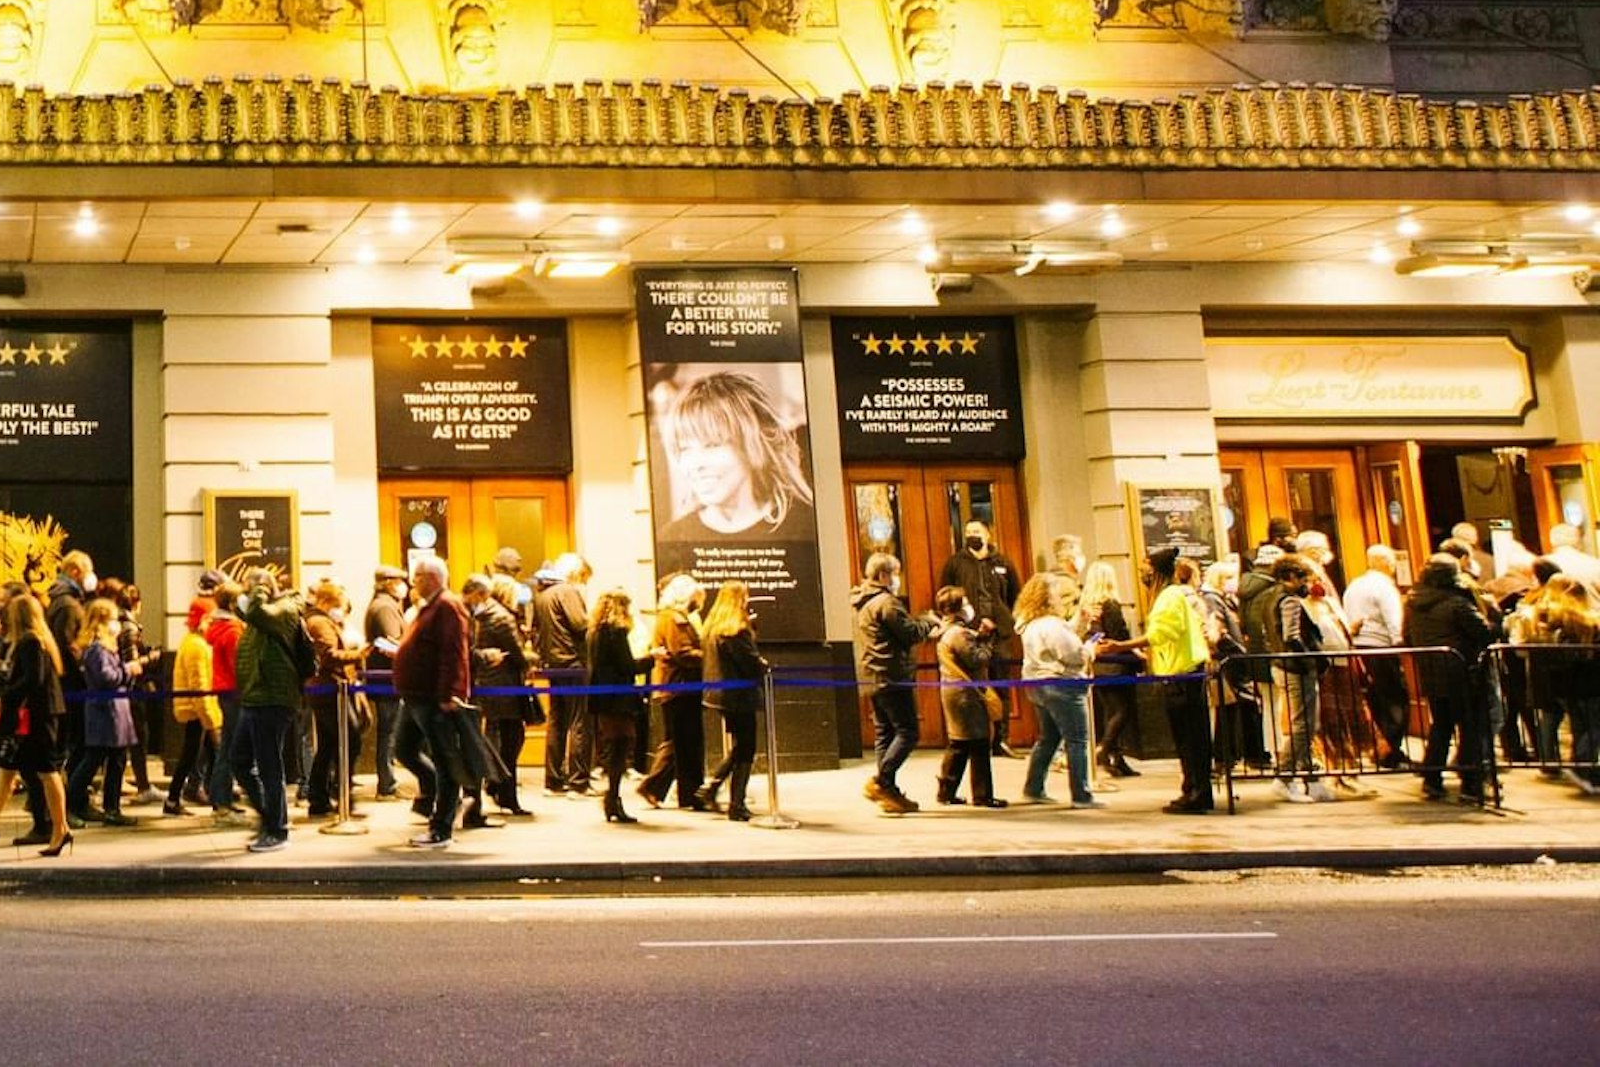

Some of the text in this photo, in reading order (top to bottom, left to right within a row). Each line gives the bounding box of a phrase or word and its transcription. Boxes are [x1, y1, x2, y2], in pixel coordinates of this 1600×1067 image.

[650, 292, 788, 305] THERE COULDN’T BE
[671, 307, 769, 319] A BETTER TIME
[666, 321, 695, 335] FOR
[697, 321, 728, 335] THIS
[860, 394, 989, 407] A SEISMIC POWER!
[41, 404, 75, 418] TALE
[410, 407, 531, 422] THIS IS AS GOOD
[866, 409, 903, 420] RARELY
[904, 409, 940, 420] HEARD
[941, 409, 955, 420] AN
[957, 409, 1008, 420] AUDIENCE
[21, 420, 50, 435] THE
[432, 424, 452, 439] AS
[455, 424, 468, 439] IT
[860, 422, 886, 432] WITH
[887, 422, 910, 432] THIS
[911, 422, 950, 432] MIGHTY
[951, 422, 959, 432] A
